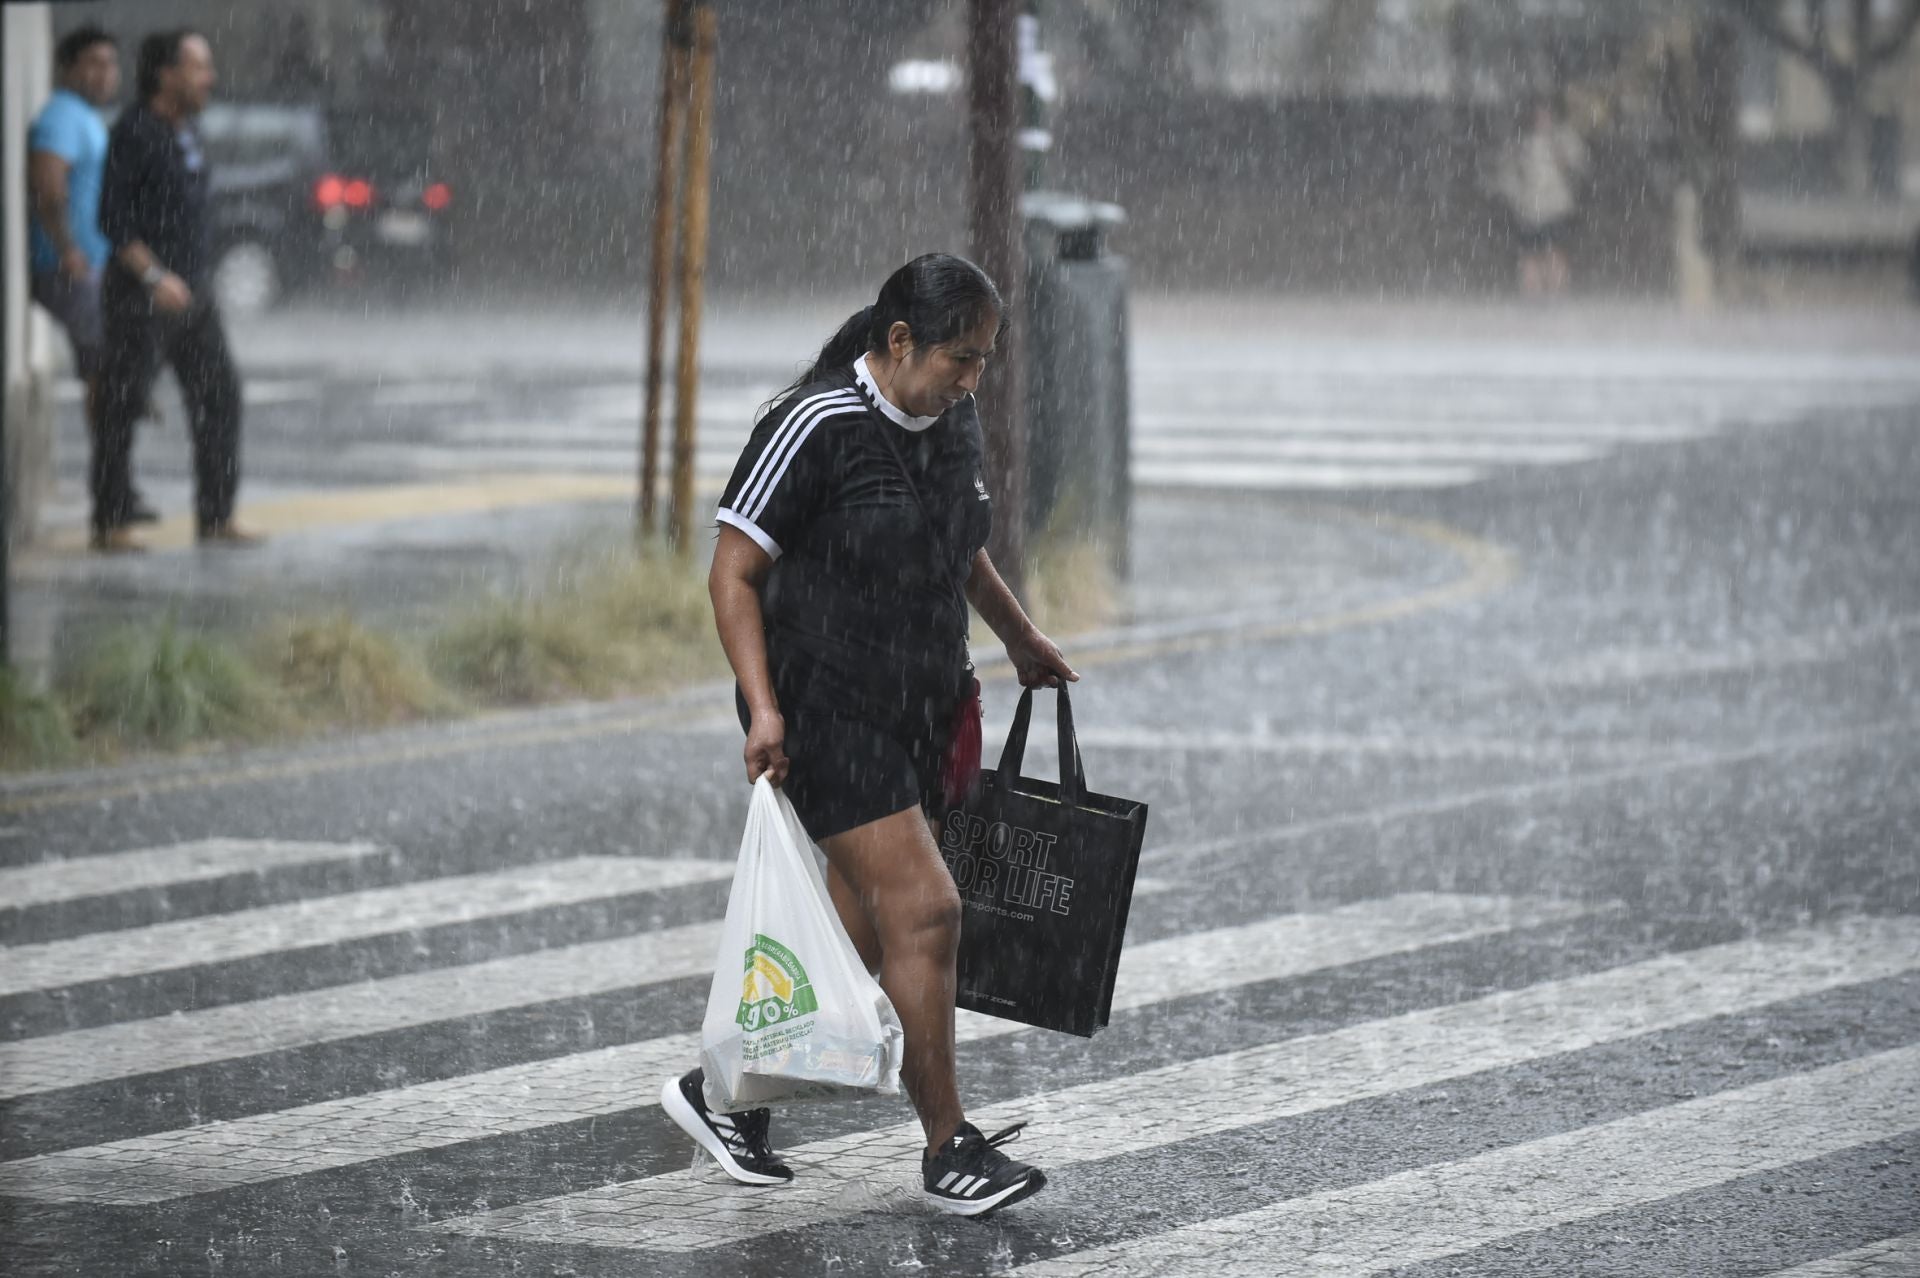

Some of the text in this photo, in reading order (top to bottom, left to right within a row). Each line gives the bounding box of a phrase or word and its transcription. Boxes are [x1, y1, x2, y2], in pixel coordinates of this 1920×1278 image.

[944, 810, 1057, 870] SPORT
[941, 847, 1074, 915] FOR LIFE
